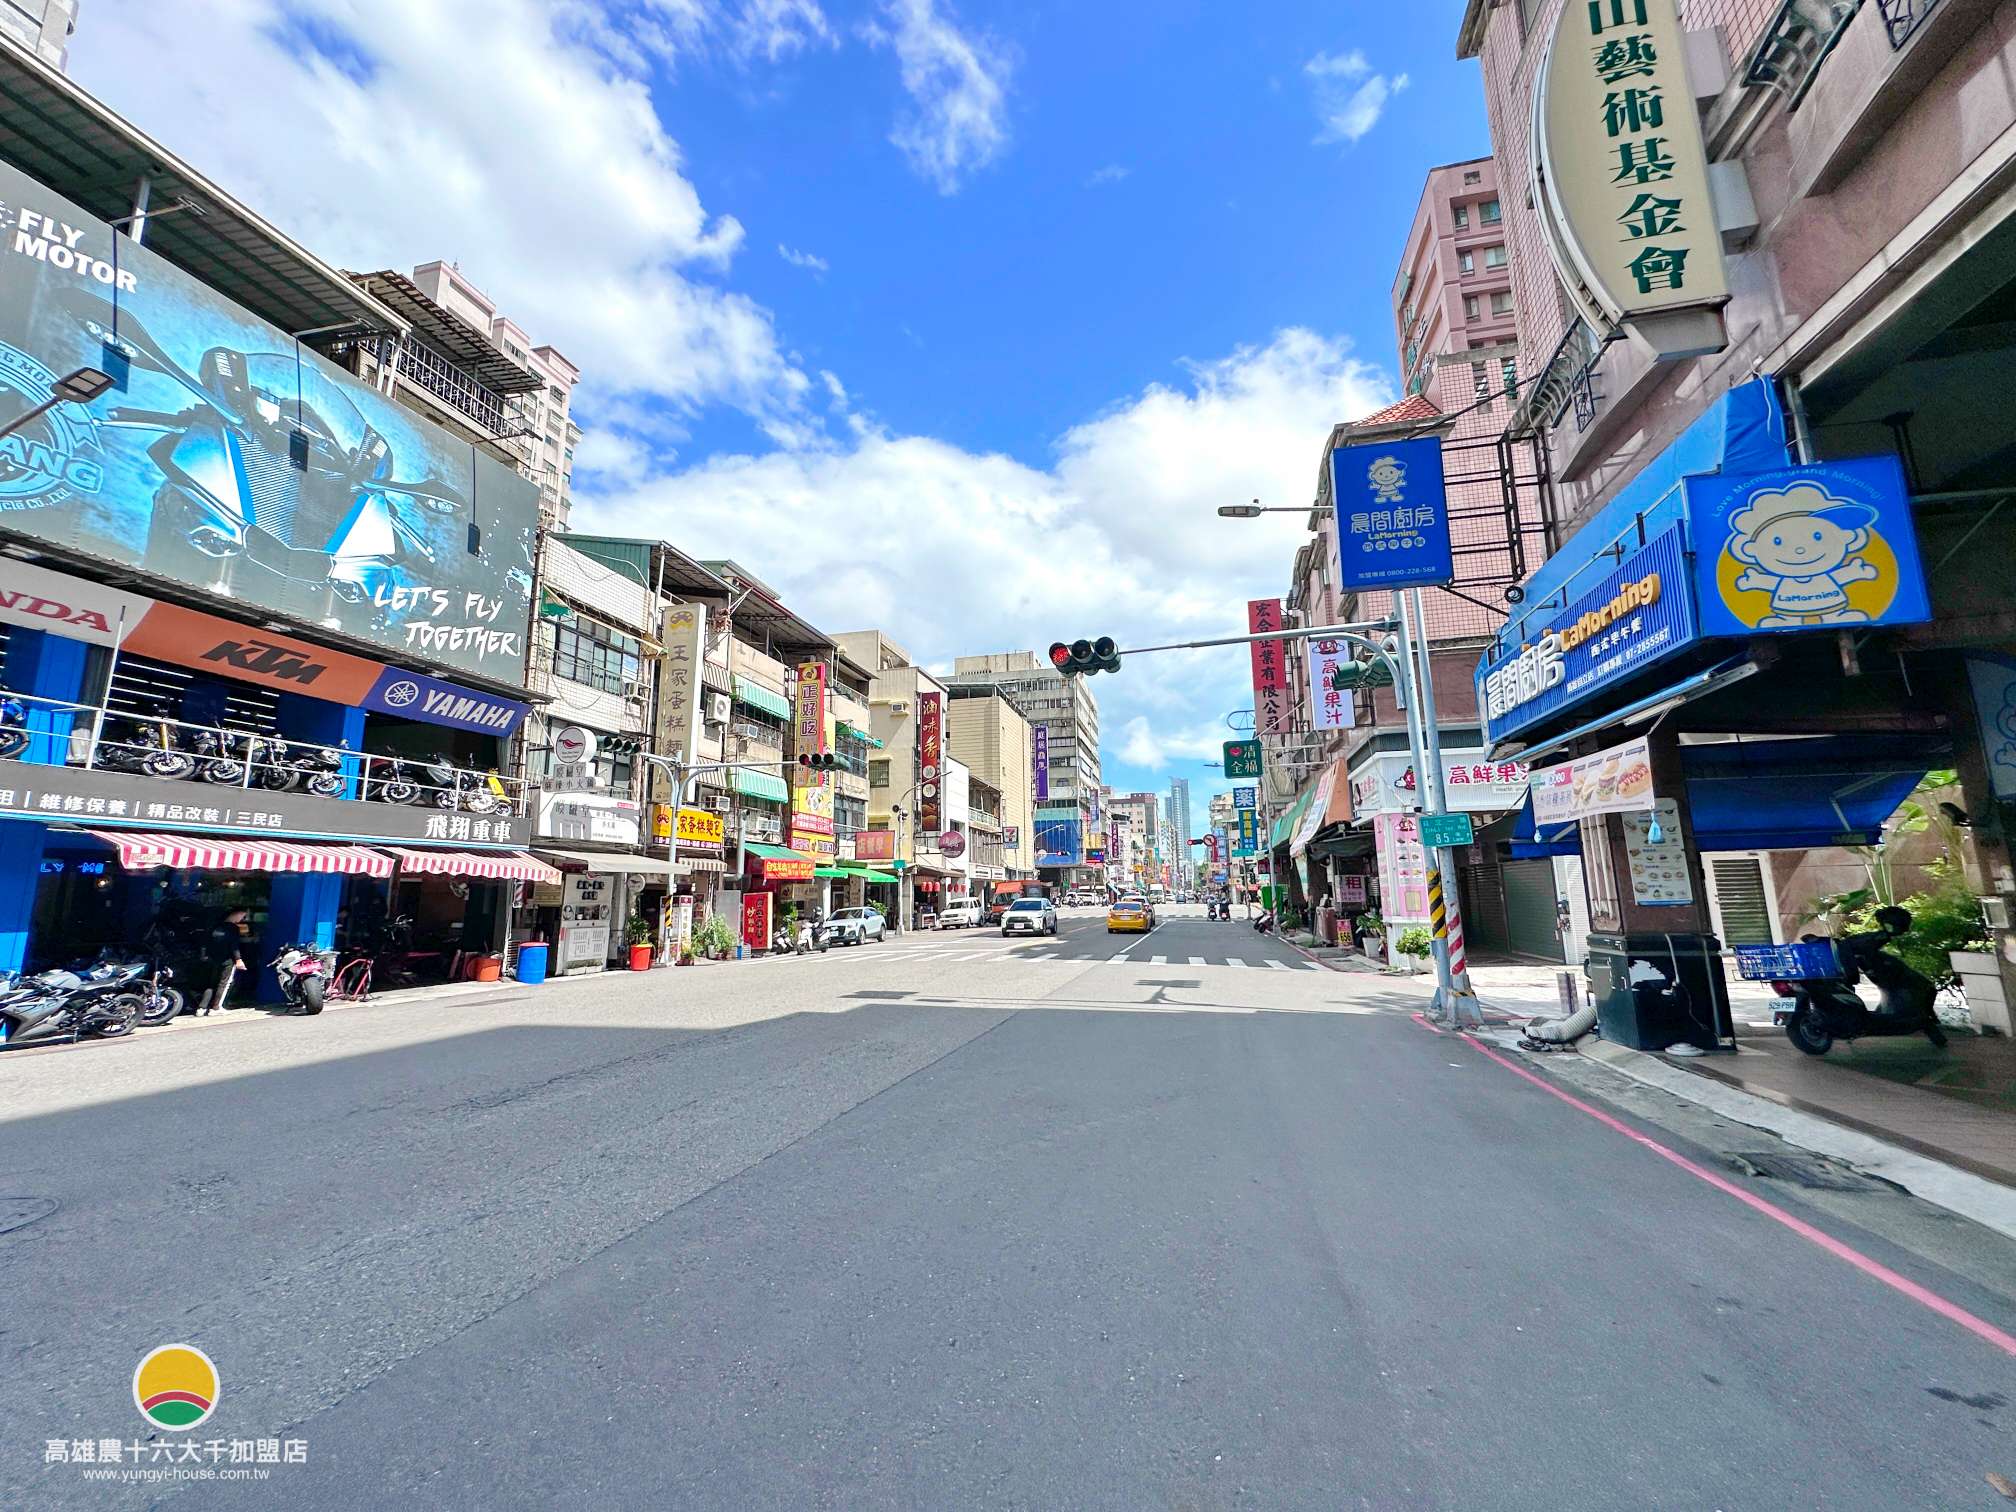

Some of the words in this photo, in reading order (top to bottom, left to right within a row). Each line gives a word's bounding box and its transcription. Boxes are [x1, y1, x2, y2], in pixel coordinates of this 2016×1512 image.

[1588, 0, 1690, 294] 山藝術基金會
[18, 207, 85, 248] FLY
[14, 231, 137, 293] MOTOR
[1350, 504, 1435, 534] 晨間廚房
[374, 582, 449, 616] LET'S
[465, 591, 504, 623] FLY
[1560, 572, 1661, 652] LaMorning
[1777, 589, 1841, 603] LaMorning
[200, 639, 328, 685] KTM
[1486, 629, 1566, 720] 晨間廚房
[421, 689, 516, 729] YAMAHA
[664, 644, 690, 784] 王家蛋糕麵
[800, 684, 818, 736] 正好吃
[39, 793, 127, 816] 維修保養
[148, 802, 220, 823] 精品改裝
[236, 811, 283, 828] 三民店
[424, 814, 512, 843] 飛翔重車
[679, 814, 721, 837] 家蛋糕麵包
[1435, 832, 1450, 844] 85
